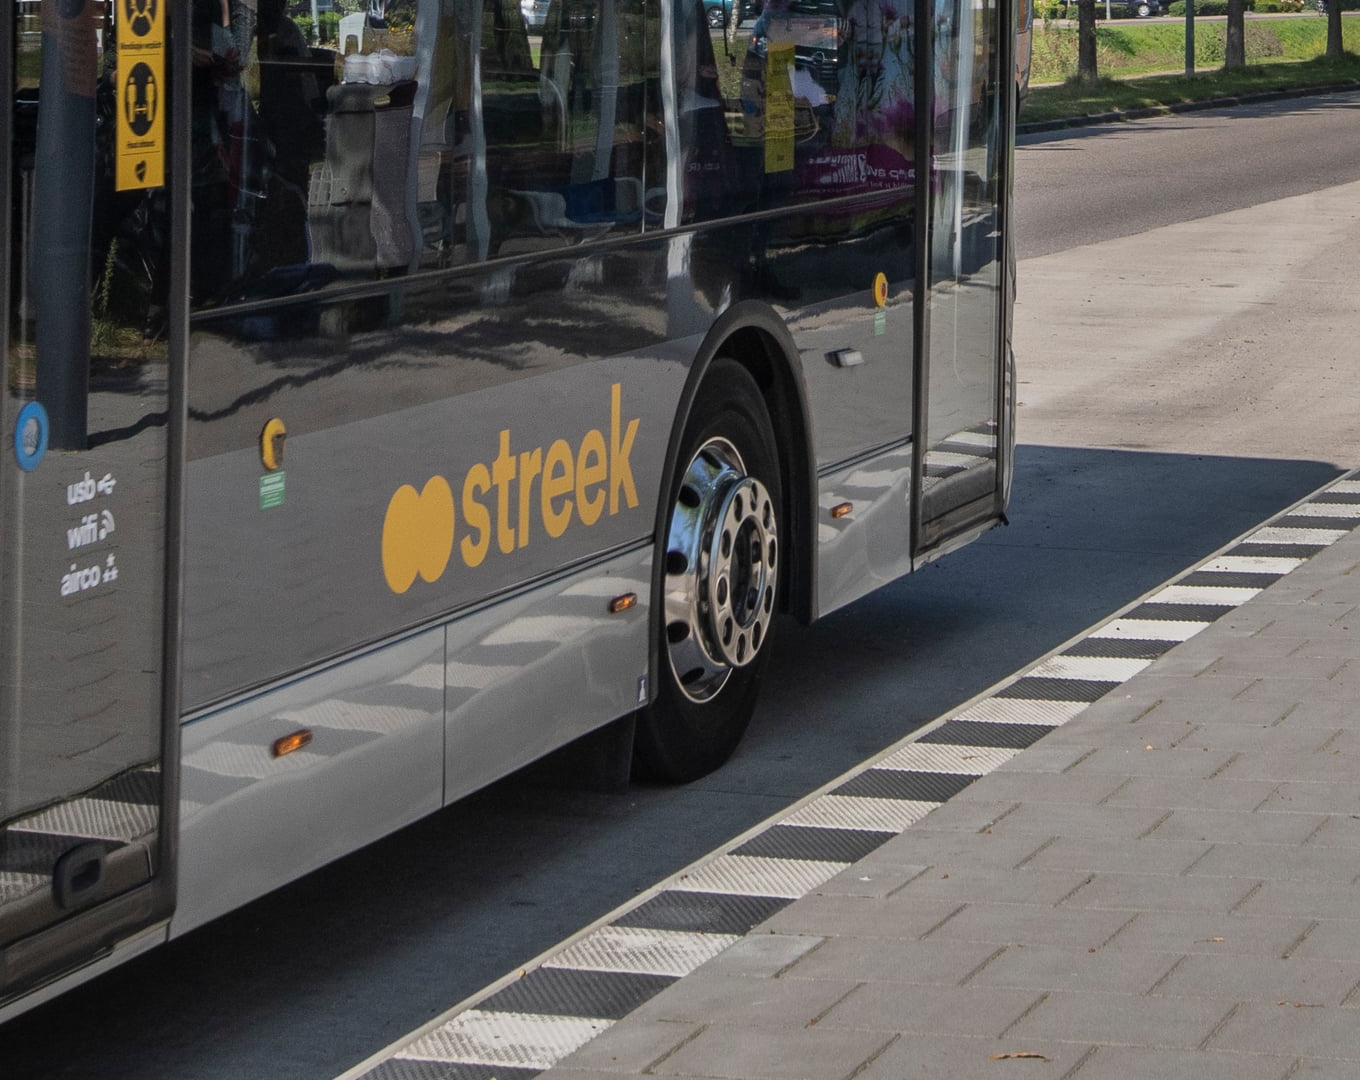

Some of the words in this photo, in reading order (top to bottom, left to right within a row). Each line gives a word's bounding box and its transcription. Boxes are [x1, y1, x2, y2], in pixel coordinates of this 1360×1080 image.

[66, 471, 96, 505] usb
[460, 383, 640, 568] streek
[67, 513, 98, 550] wifi
[61, 563, 101, 597] airco
